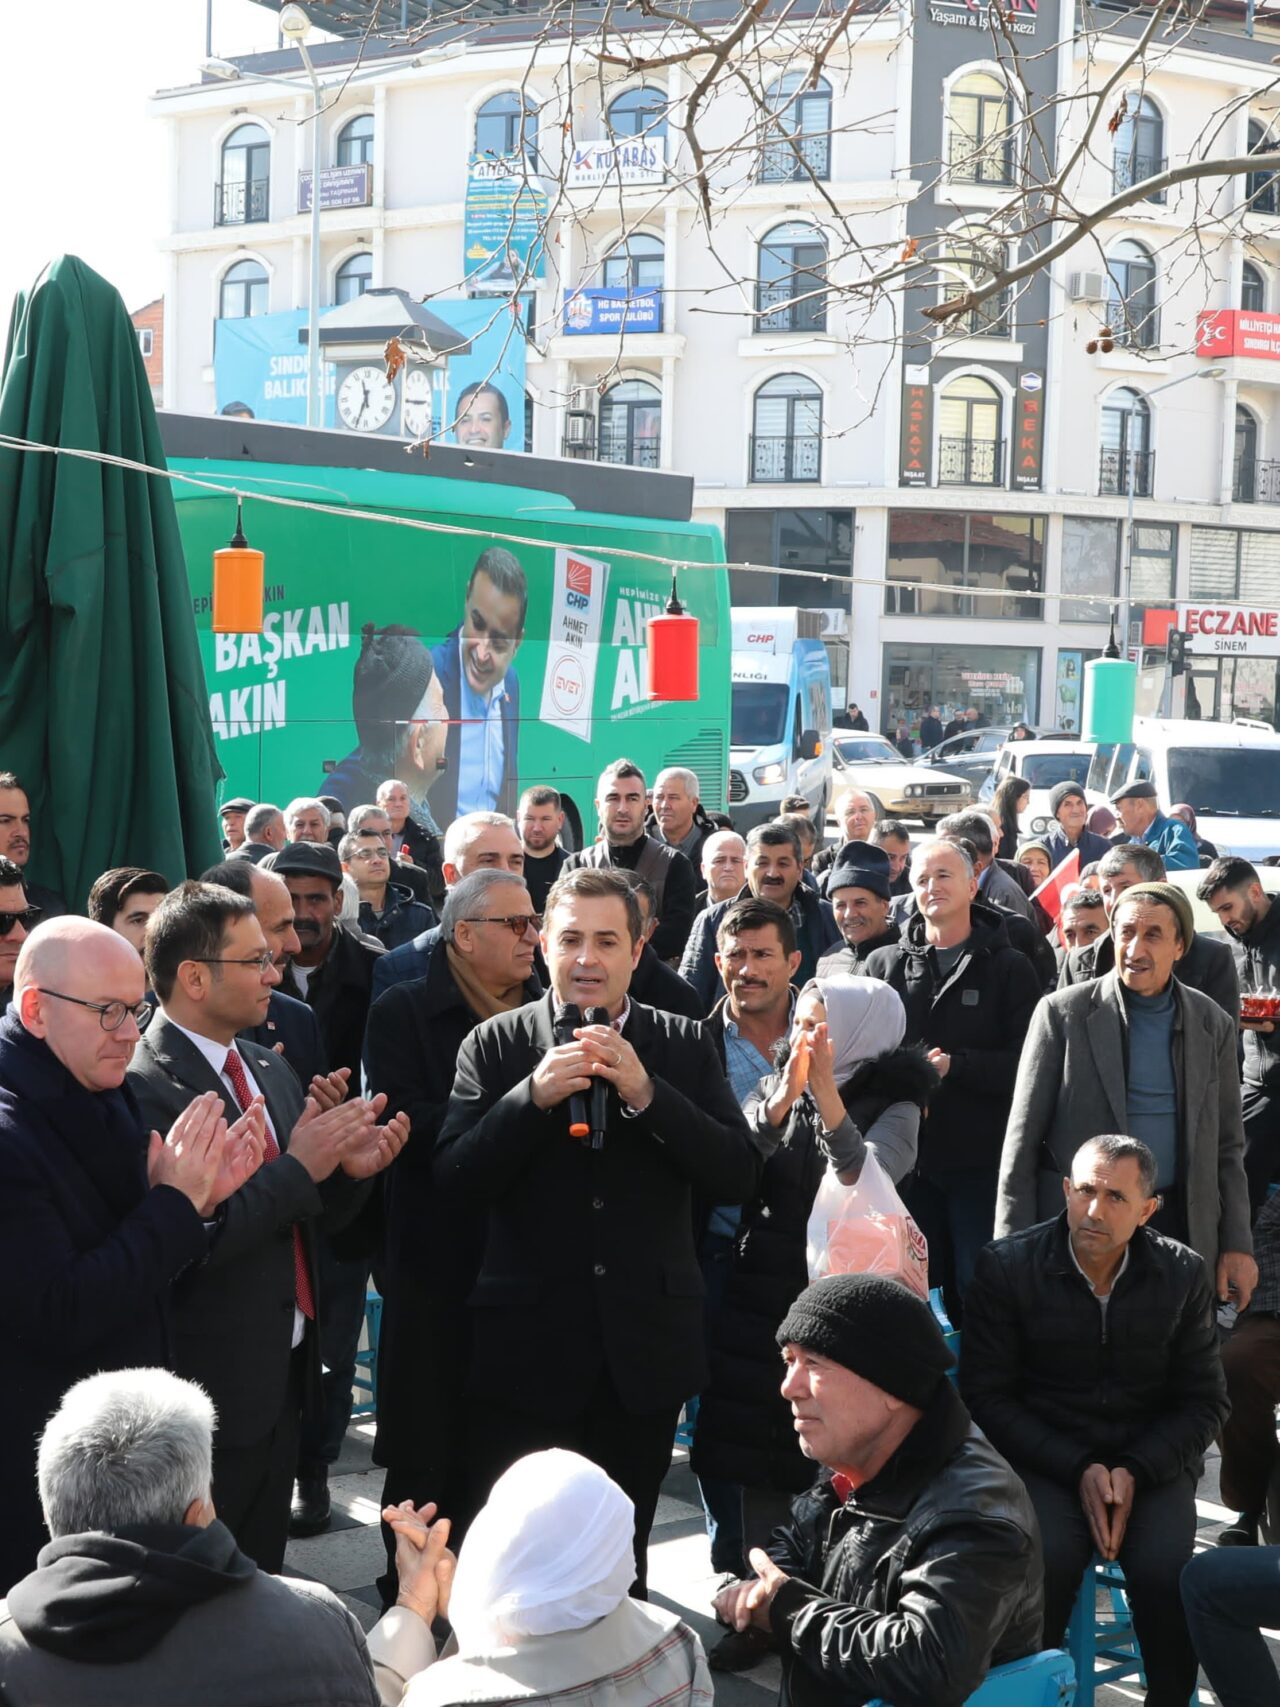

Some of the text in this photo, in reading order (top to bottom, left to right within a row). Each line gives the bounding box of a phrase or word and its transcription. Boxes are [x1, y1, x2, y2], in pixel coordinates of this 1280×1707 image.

[930, 8, 966, 25] Yaşam
[968, 16, 977, 26] &
[991, 16, 1036, 35] Mrkezi
[625, 310, 654, 321] ULÜBÜ
[908, 388, 924, 468] HASKAYA
[566, 591, 589, 610] CHP
[562, 615, 588, 635] AHMET
[1185, 609, 1278, 636] ECZANE
[215, 601, 350, 679] BAŞKAN
[565, 631, 583, 649] AKIN
[747, 634, 774, 643] CHP
[1214, 637, 1247, 651] SİNEM
[556, 676, 580, 694] EVET
[209, 679, 286, 740] AKIN
